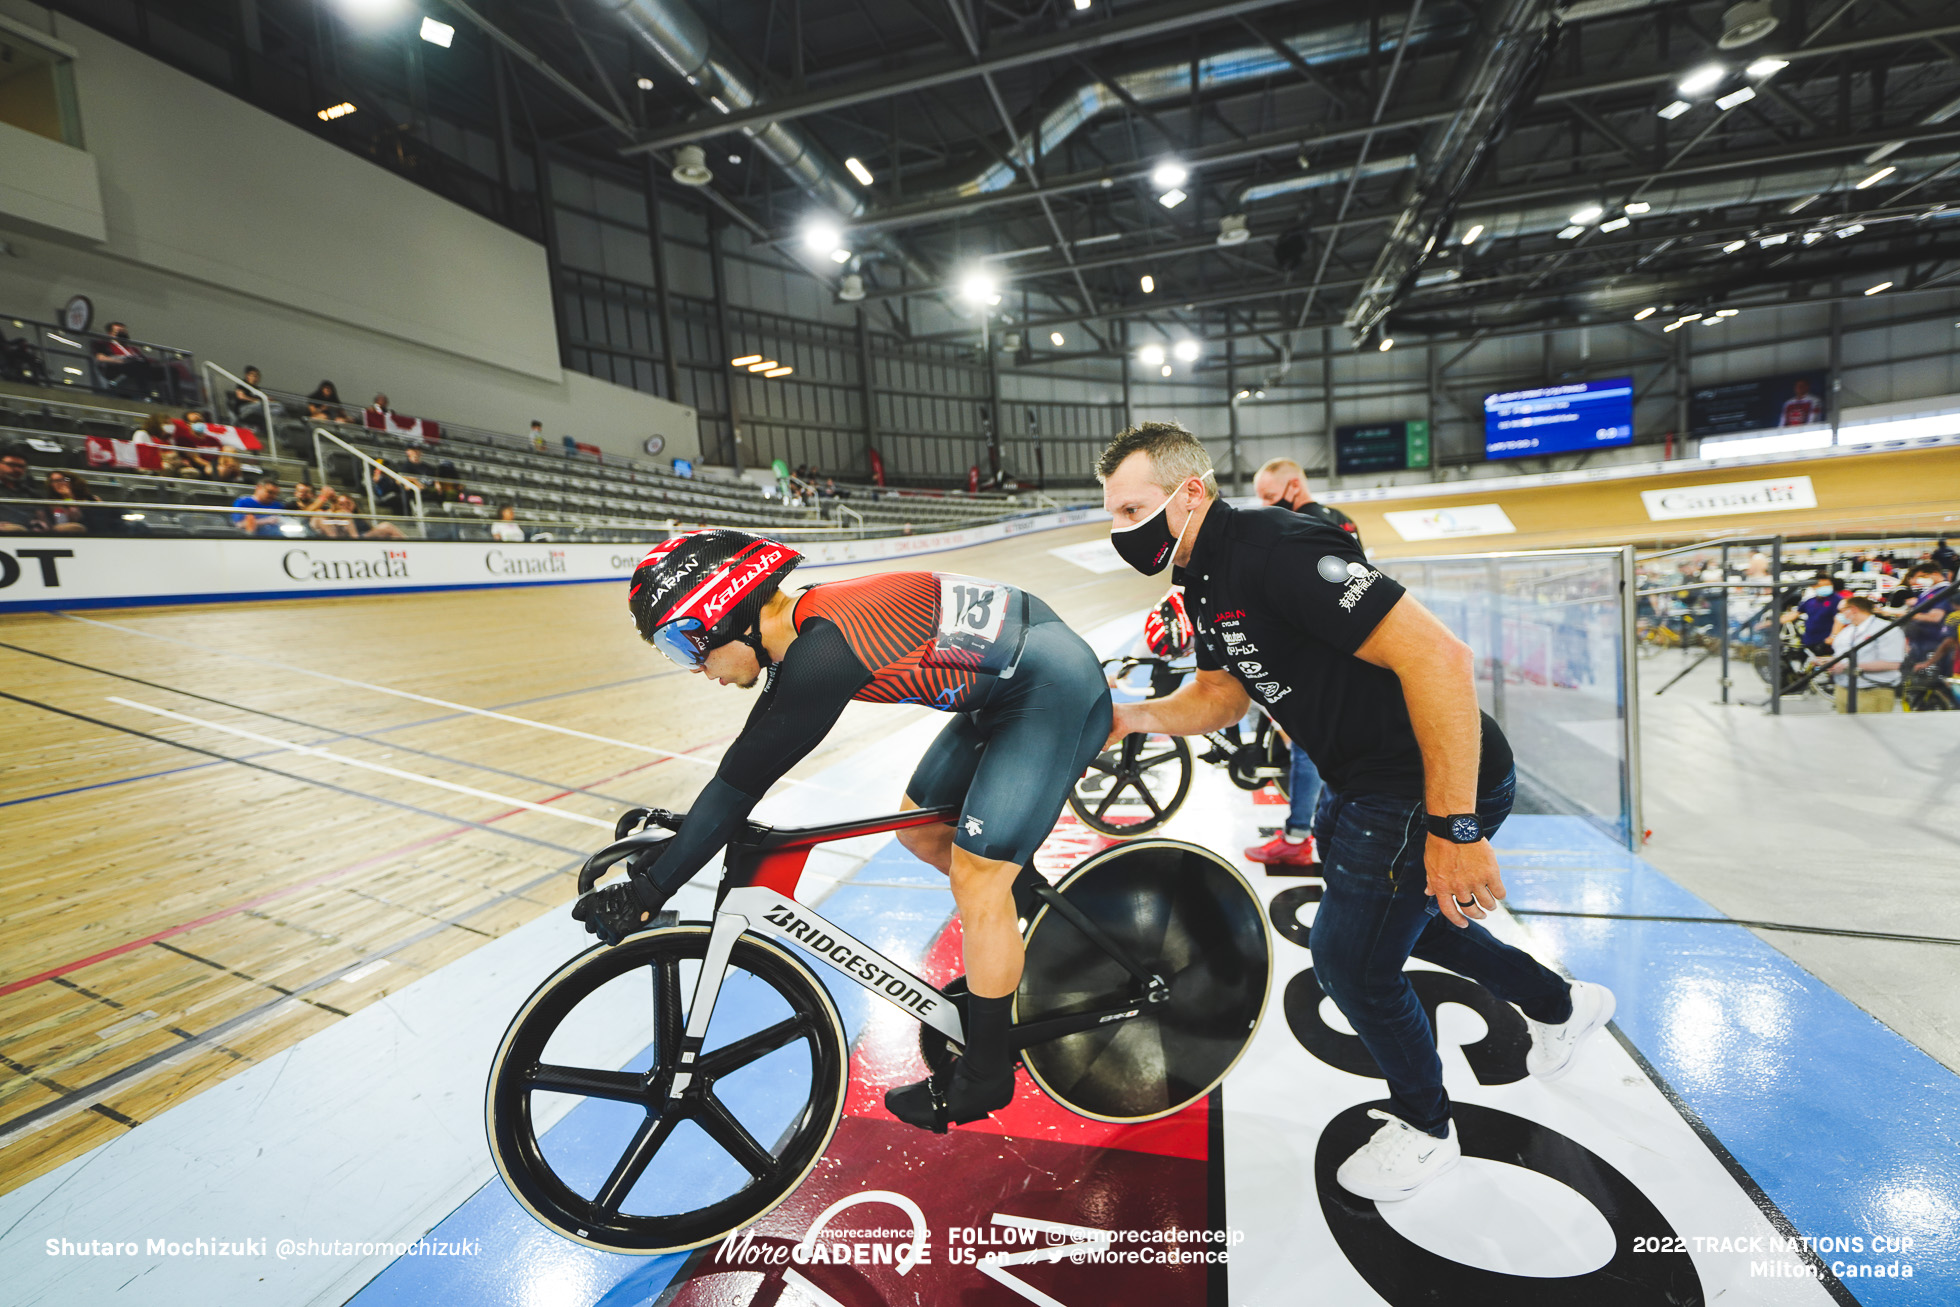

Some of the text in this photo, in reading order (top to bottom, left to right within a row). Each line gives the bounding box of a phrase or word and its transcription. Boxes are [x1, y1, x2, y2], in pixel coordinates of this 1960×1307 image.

[1661, 487, 1794, 512] Canada
[283, 549, 409, 581] Canada
[485, 550, 567, 576] Canada
[650, 557, 699, 607] JAPAN
[702, 549, 783, 619] Kabuto
[952, 585, 994, 630] 113
[1213, 608, 1246, 623] JAPAN
[762, 904, 938, 1016] BRIDGESTONE
